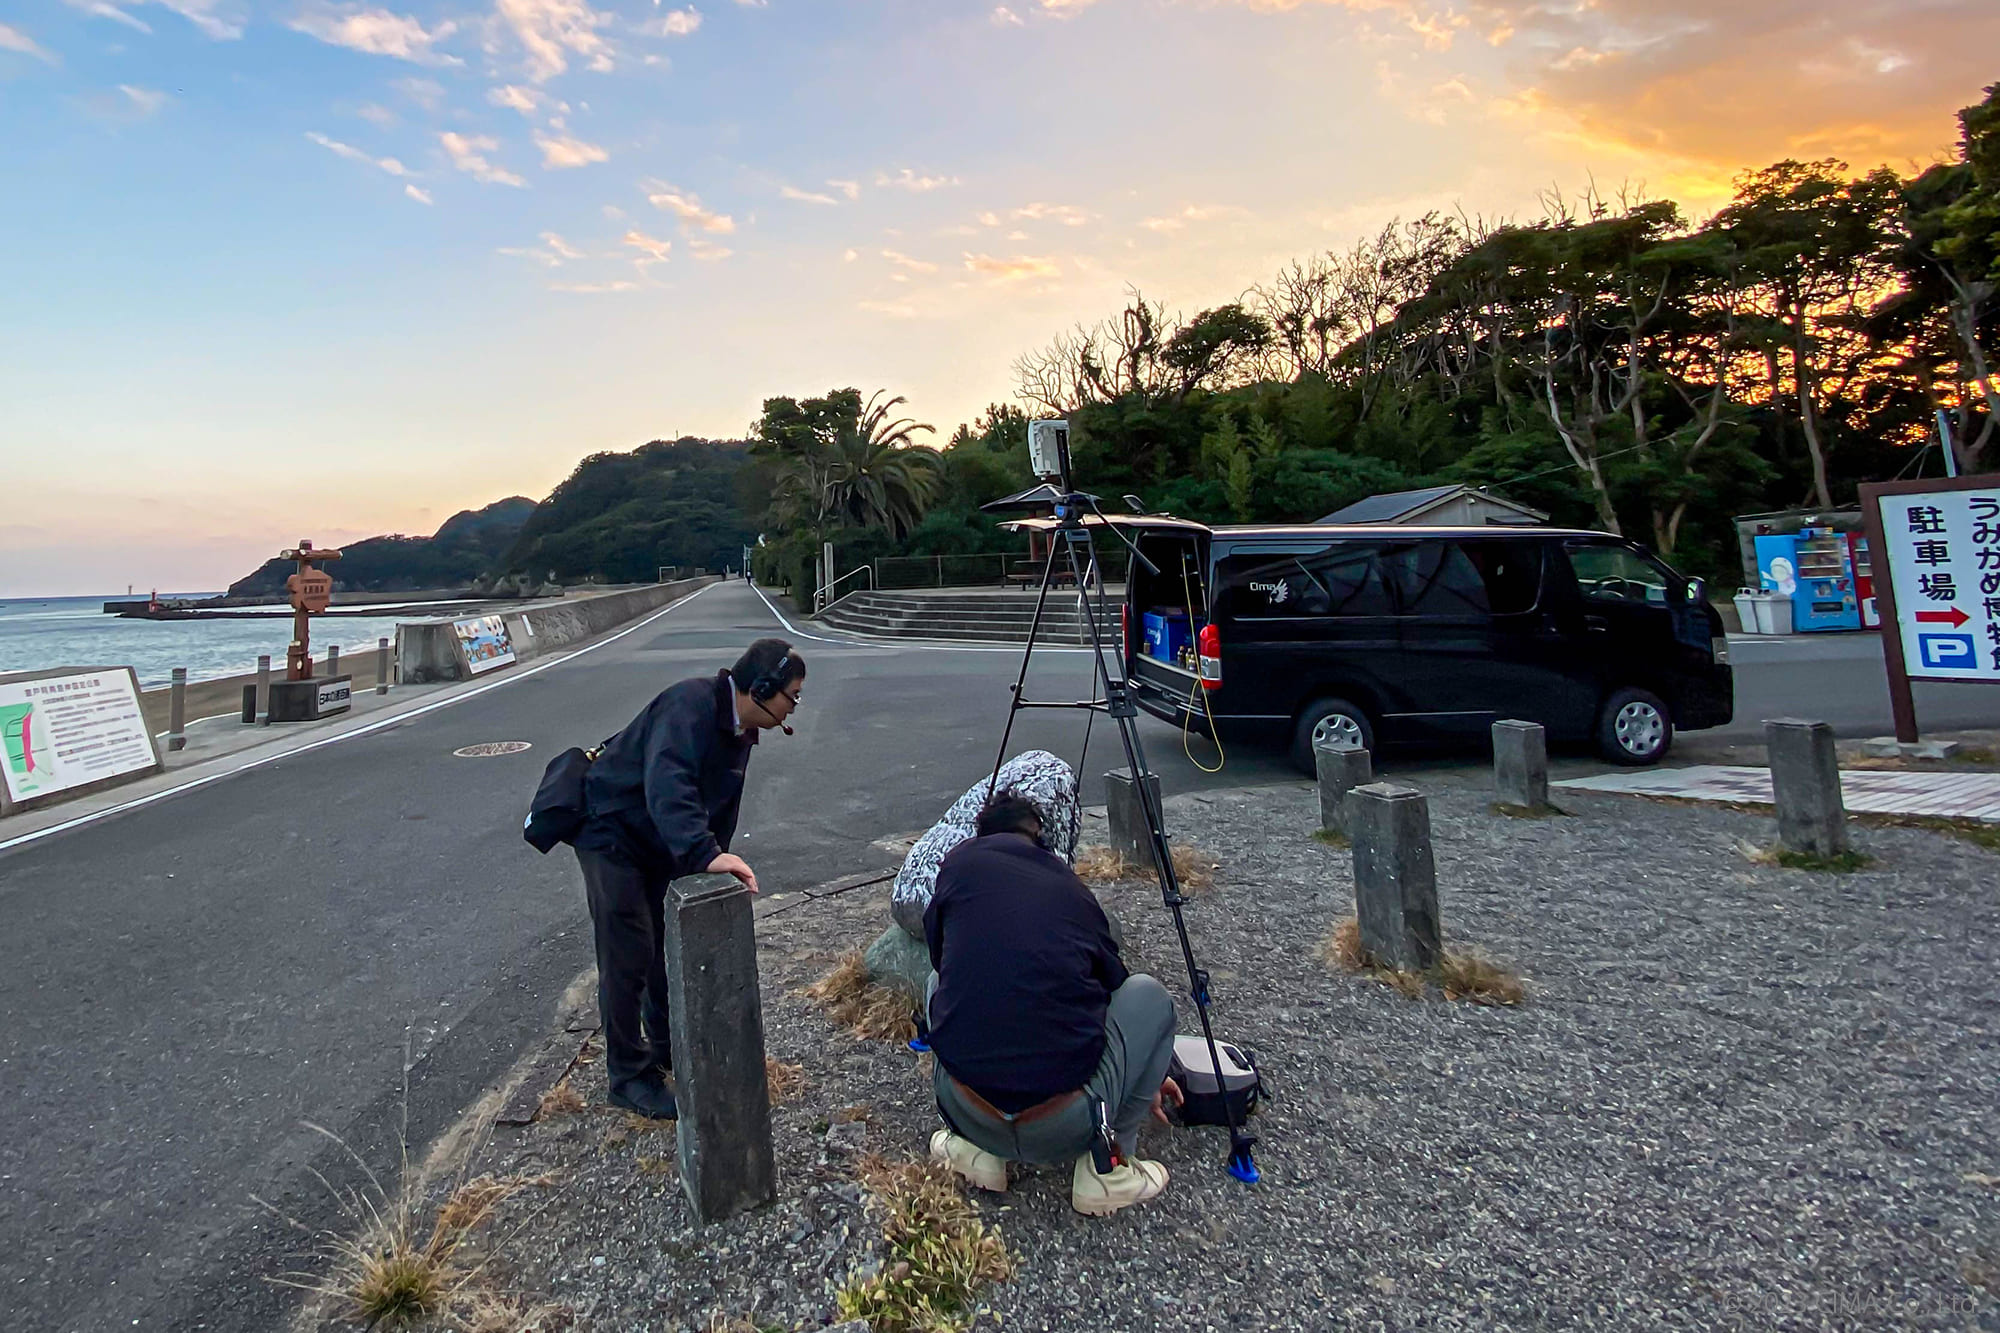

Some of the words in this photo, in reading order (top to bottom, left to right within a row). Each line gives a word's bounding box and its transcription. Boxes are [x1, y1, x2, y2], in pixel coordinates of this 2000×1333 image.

[1906, 505, 1957, 601] 駐車場
[1968, 497, 2000, 671] うみがめ
